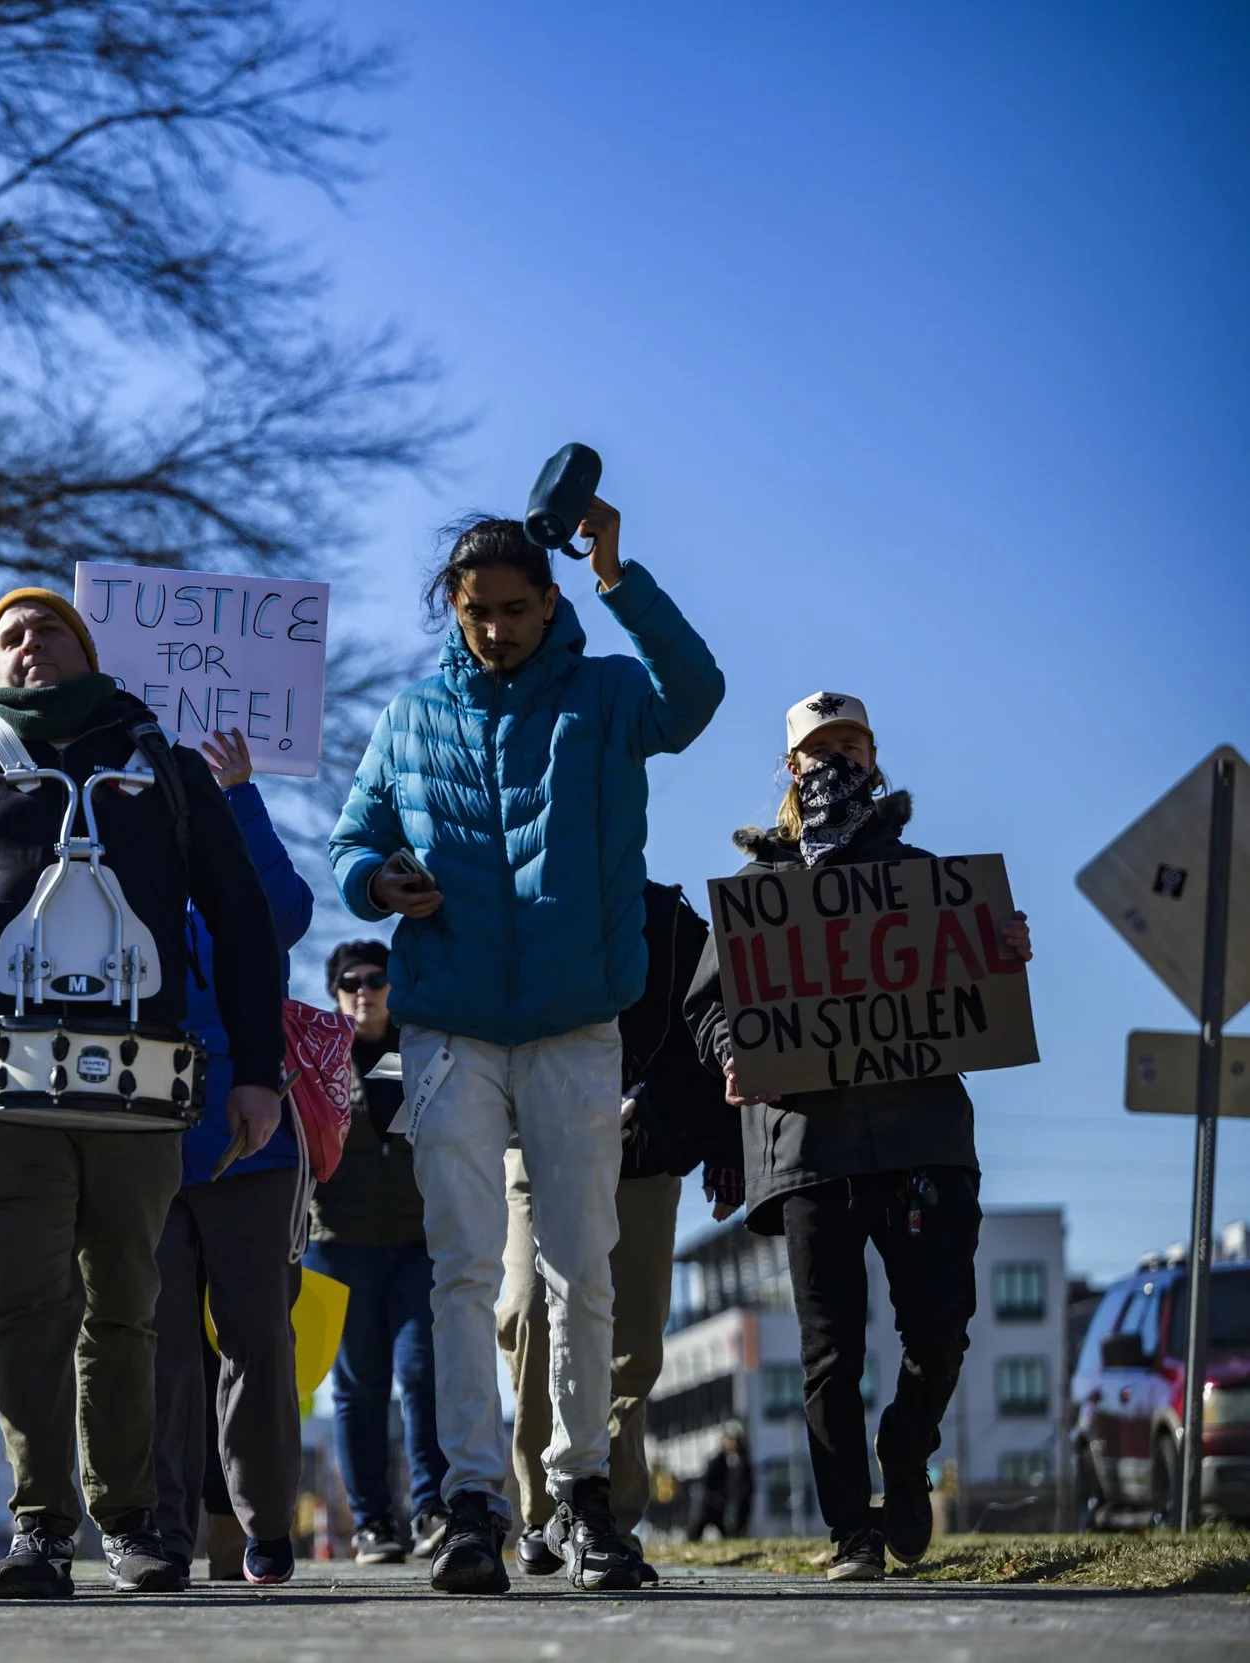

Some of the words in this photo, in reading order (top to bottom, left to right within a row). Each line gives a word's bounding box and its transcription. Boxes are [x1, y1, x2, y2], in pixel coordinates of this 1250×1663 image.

[90, 579, 322, 643] JUSTICE
[157, 642, 231, 678] FOR
[112, 677, 296, 751] ENEE!
[718, 874, 788, 933] NO
[812, 861, 909, 917] ONE
[930, 856, 973, 907] IS
[68, 976, 87, 992] M
[728, 902, 1027, 1007] ILLEGAL
[732, 1002, 803, 1053] ON
[810, 984, 988, 1049] STOLEN
[828, 1042, 942, 1087] LAND
